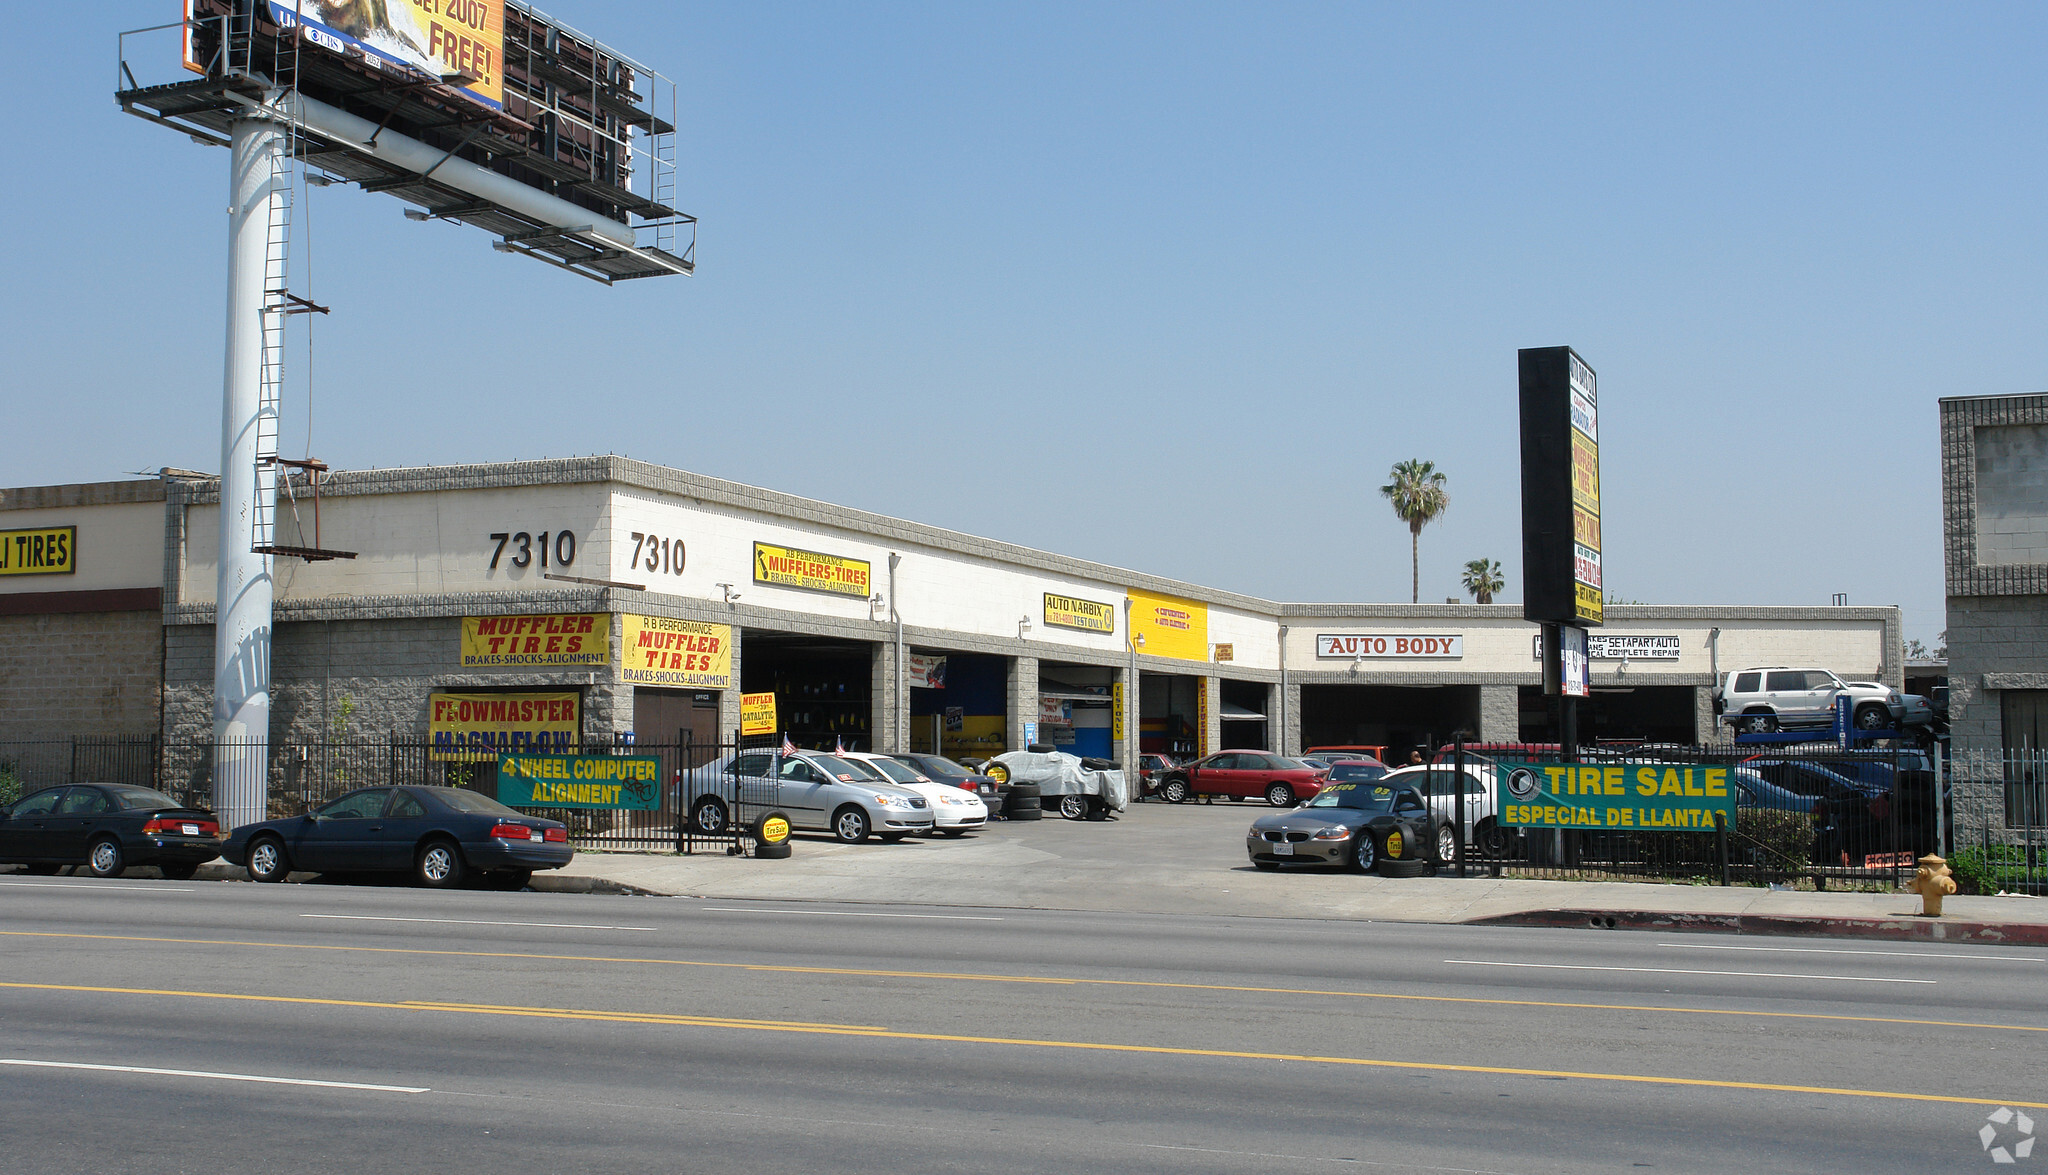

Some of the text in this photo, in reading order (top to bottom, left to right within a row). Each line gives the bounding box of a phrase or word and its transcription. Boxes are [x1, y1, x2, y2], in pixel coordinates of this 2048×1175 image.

[319, 33, 339, 50] CBS
[429, 20, 492, 86] FREE!
[16, 534, 67, 567] TIRES
[489, 529, 576, 569] 7310
[631, 531, 686, 577] 7310
[796, 551, 843, 567] PERFORMANCE
[1047, 597, 1102, 617] AUTO NARBIX
[477, 616, 595, 635] MUFFLER
[659, 619, 712, 635] PERFORMANCE
[1074, 616, 1087, 626] TEST
[1088, 618, 1103, 629] ONLY
[488, 636, 582, 654] TIRES
[637, 631, 720, 653] MUFFLER
[1329, 638, 1386, 653] AUTO
[1396, 638, 1453, 654] BODY
[645, 651, 711, 672] TIRES
[743, 695, 773, 705] MUFFLER
[435, 700, 575, 722] FLOWMASTER
[743, 711, 774, 721] CATALYTIC
[434, 731, 573, 754] MAGNAFLOW
[502, 757, 656, 781] 4 WHEEL COMPUTER
[1545, 767, 1727, 797] TIRE SALE
[531, 782, 622, 804] ALIGNMENT
[1505, 805, 1601, 825] ESPECIAL
[1606, 808, 1634, 826] DE
